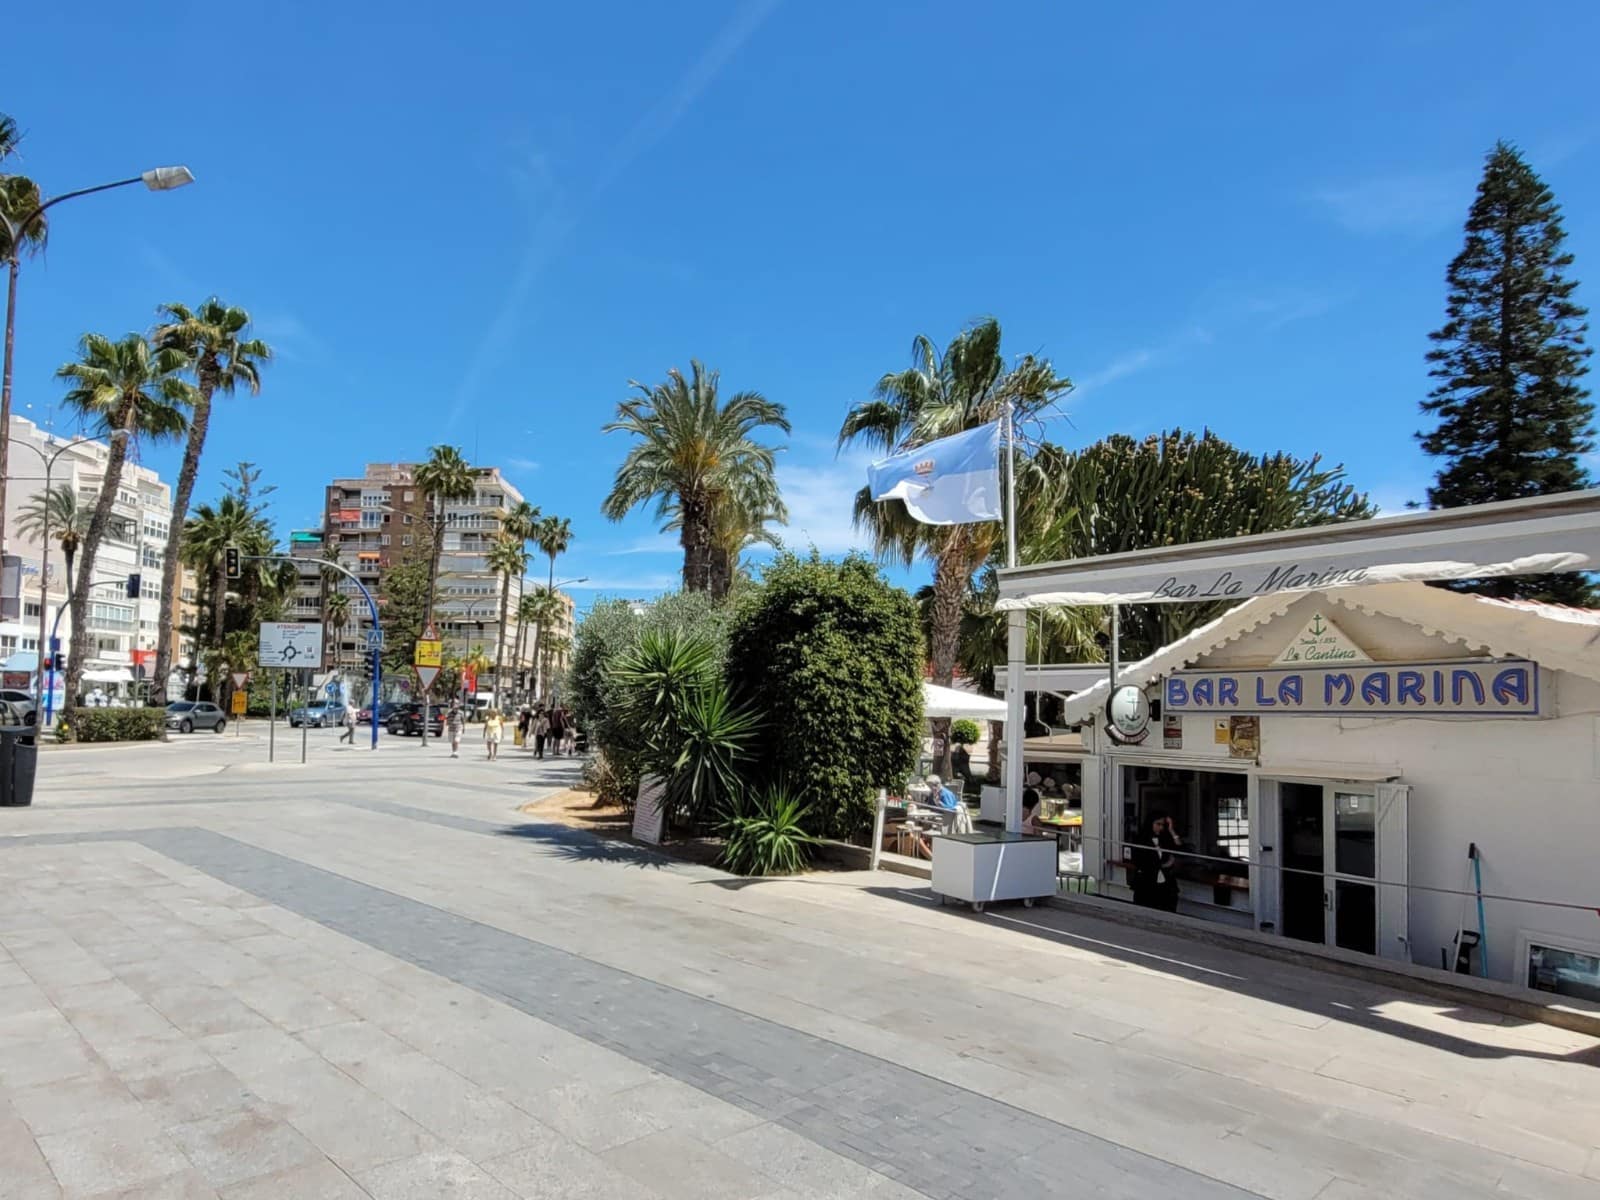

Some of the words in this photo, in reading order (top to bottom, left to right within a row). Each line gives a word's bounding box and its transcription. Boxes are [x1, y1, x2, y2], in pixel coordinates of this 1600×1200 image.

[1150, 576, 1198, 599] Bar
[1200, 571, 1243, 596] La
[1253, 564, 1369, 593] Marina
[1282, 647, 1299, 661] La
[1304, 645, 1356, 661] Cantina
[1168, 677, 1239, 706] BAR
[1256, 675, 1303, 706] LA
[1324, 668, 1529, 706] MARINA
